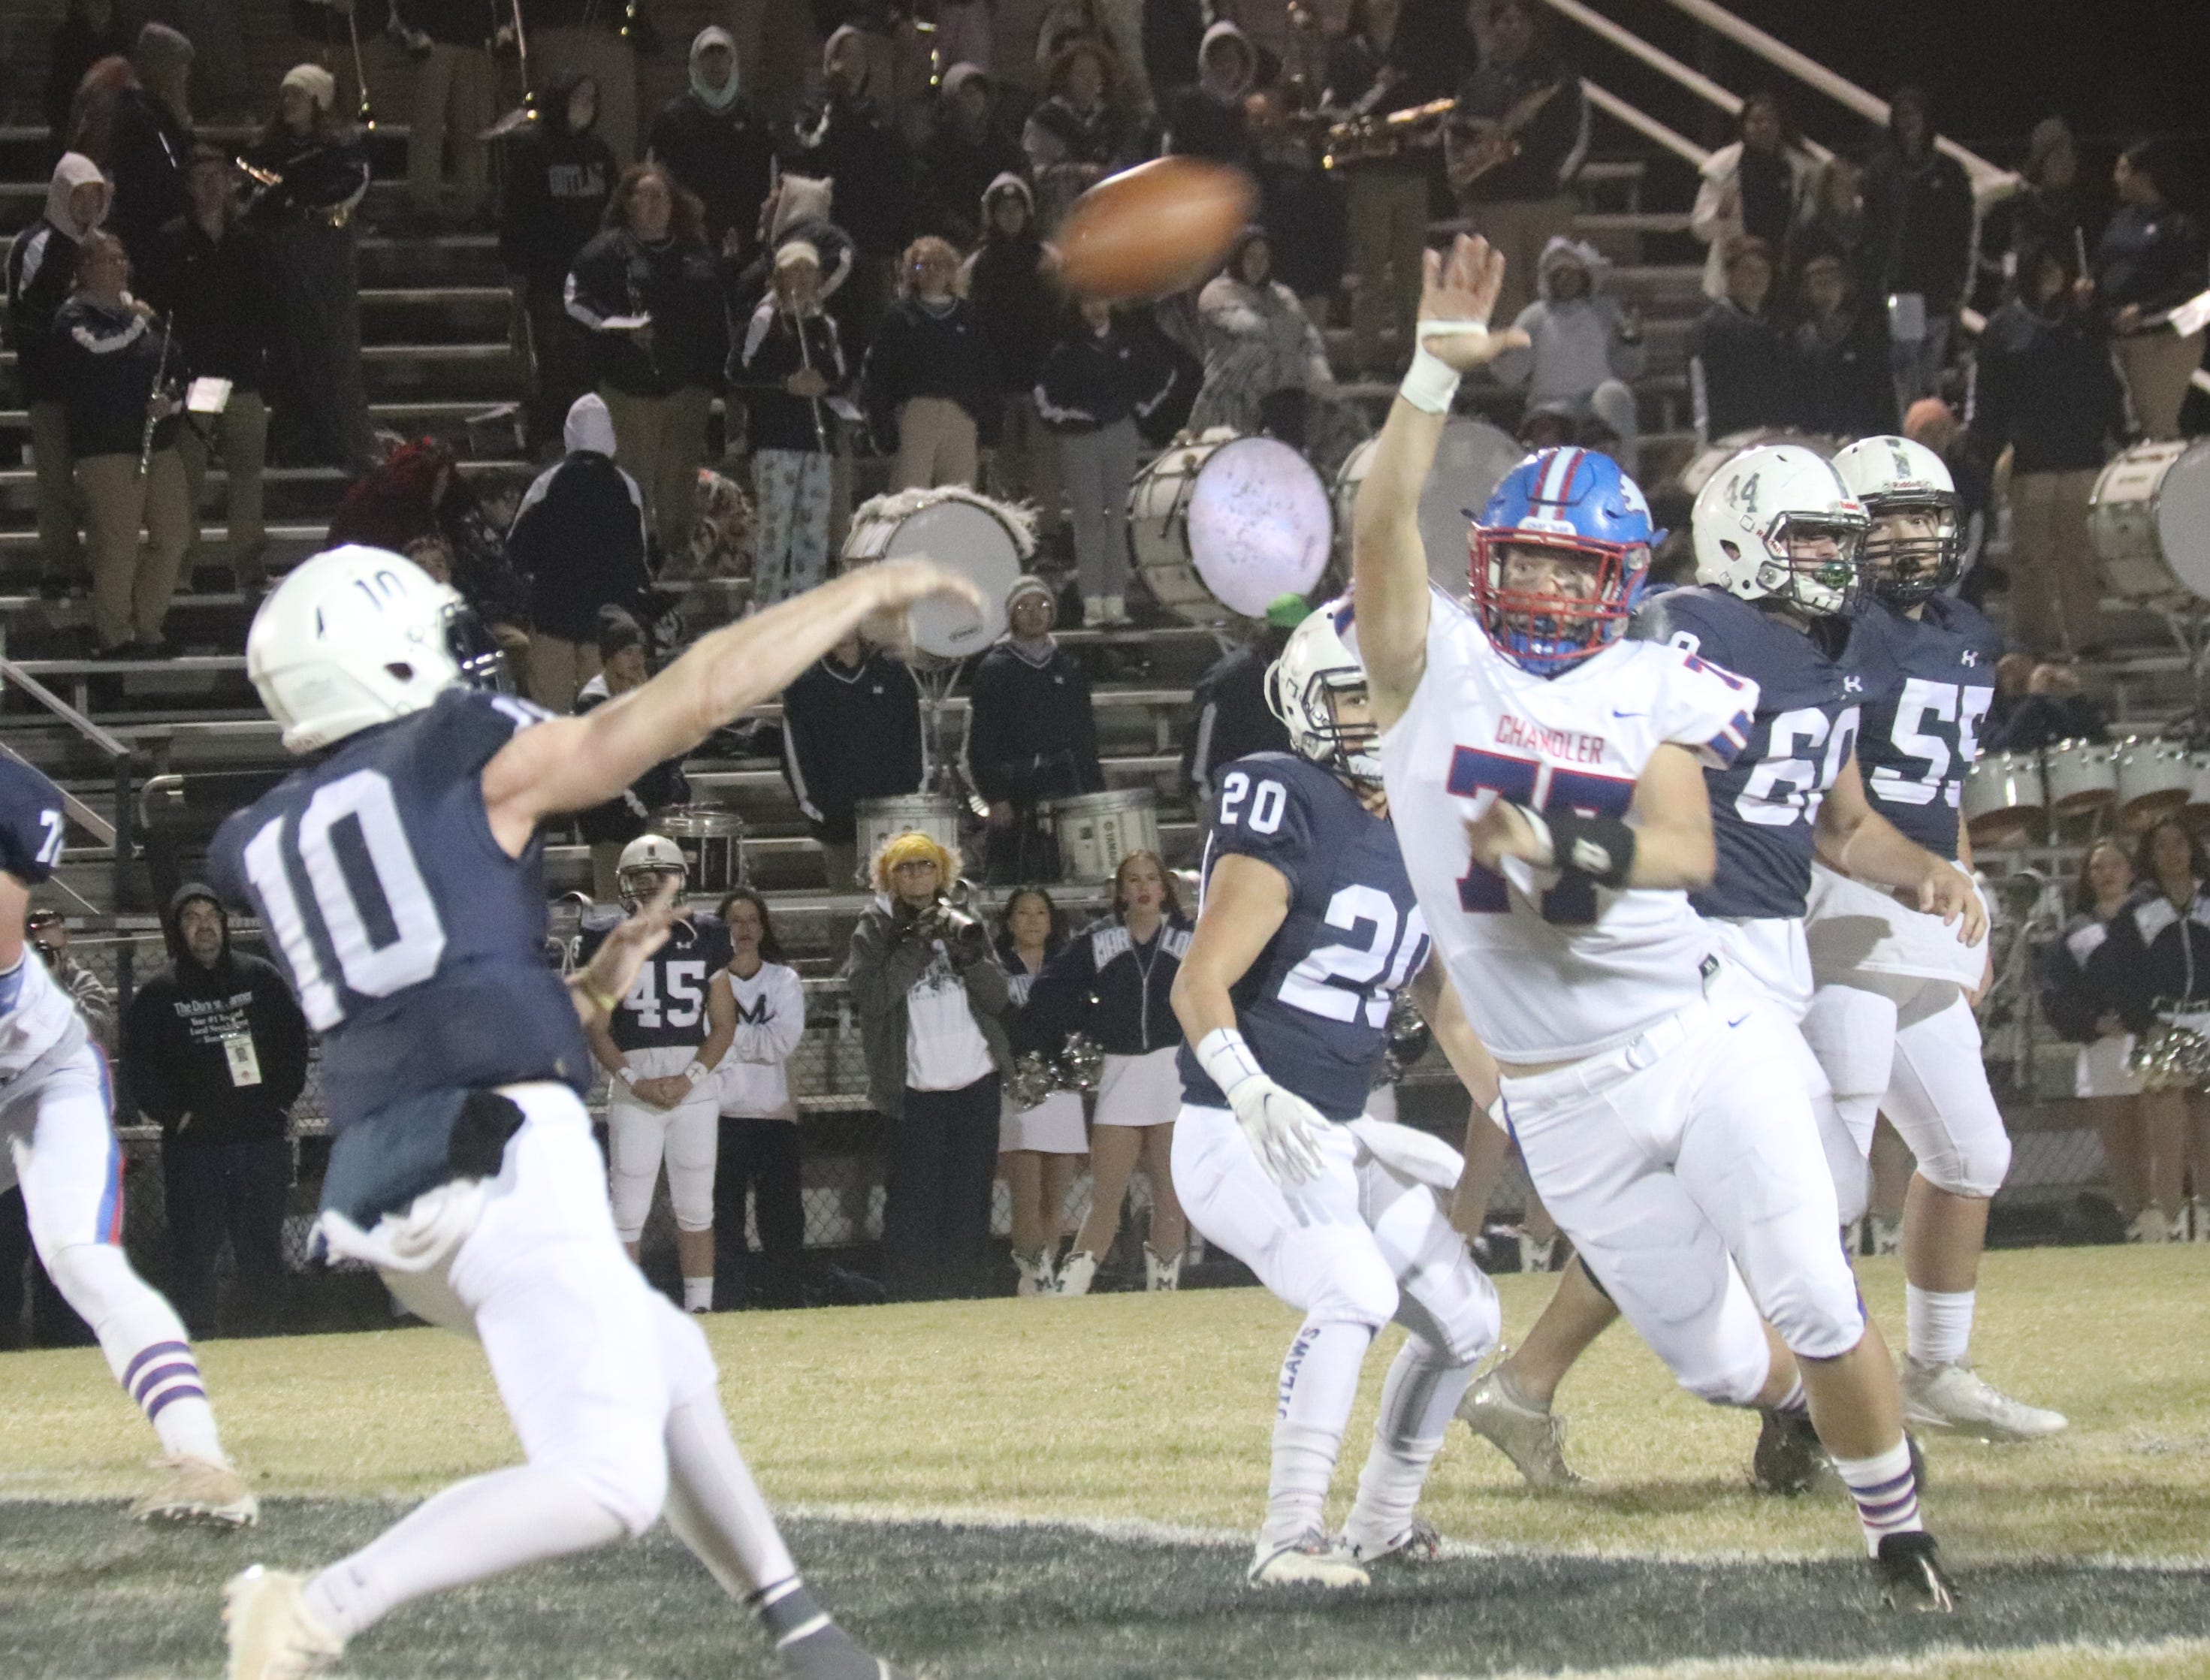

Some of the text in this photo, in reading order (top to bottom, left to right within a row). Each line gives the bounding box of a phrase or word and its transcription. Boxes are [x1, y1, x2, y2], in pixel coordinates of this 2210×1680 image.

[1725, 472, 1760, 512] 44
[1495, 714, 1605, 765] CHANDLER
[1220, 771, 1287, 834] 20
[243, 768, 447, 1032] 10
[623, 960, 706, 1028] 45
